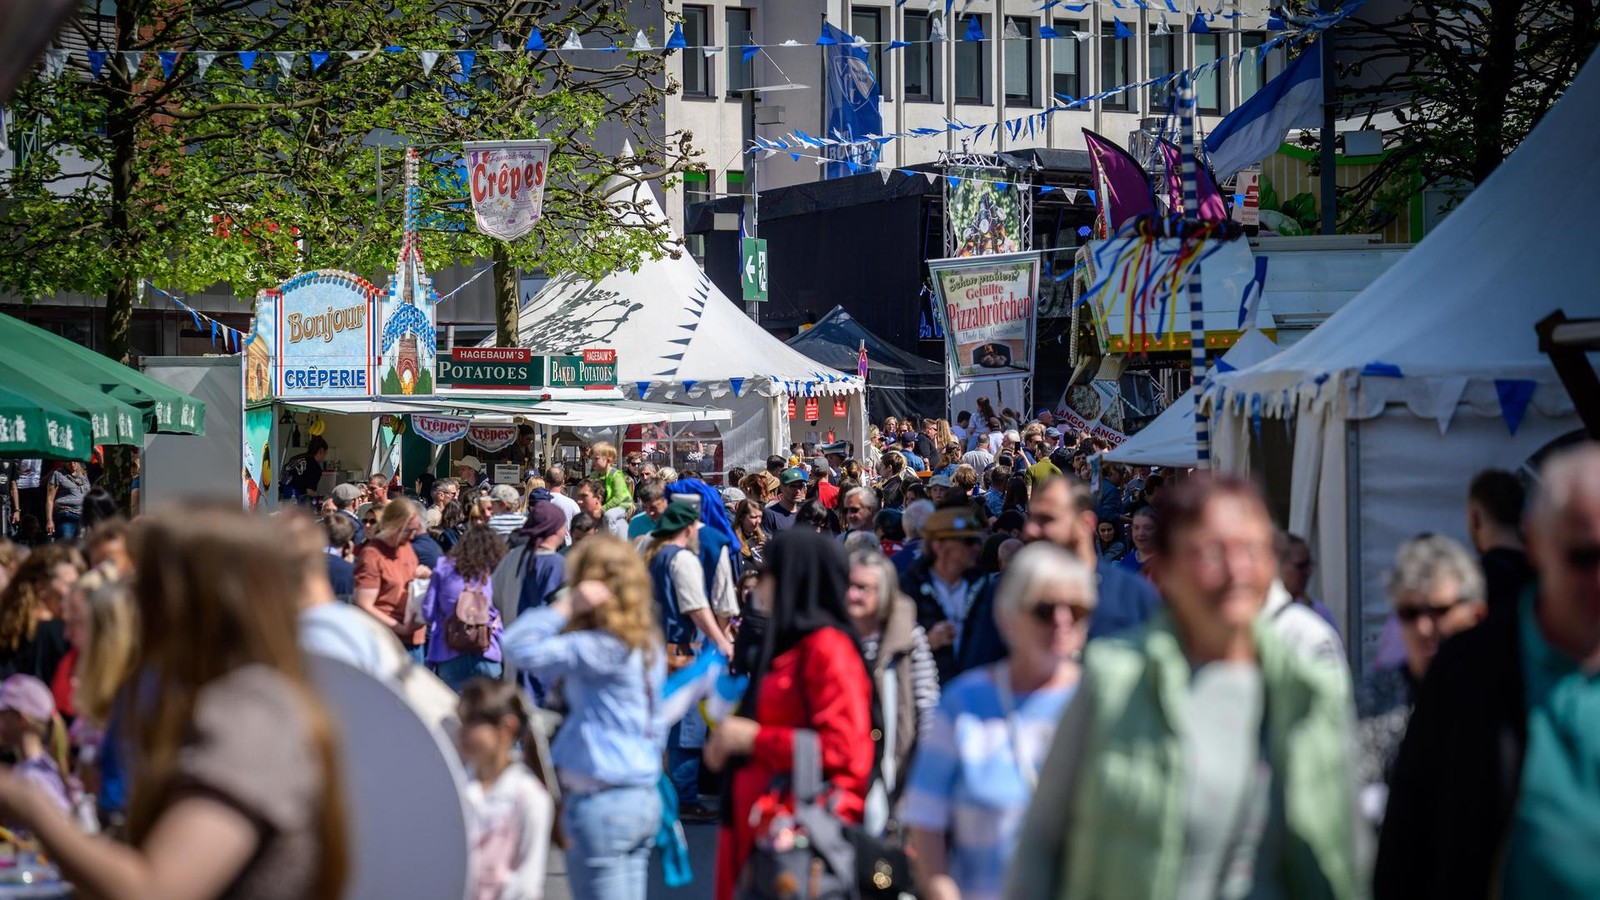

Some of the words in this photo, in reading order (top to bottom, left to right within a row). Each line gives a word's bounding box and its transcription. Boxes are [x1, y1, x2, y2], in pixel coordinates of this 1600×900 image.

[473, 162, 543, 203] Crêpes
[949, 275, 978, 292] Schon
[966, 283, 1004, 300] Gefüllte
[947, 291, 1031, 333] Pizzabrötchen
[288, 304, 366, 344] Bonjour
[460, 350, 524, 360] HAGEBAUM'S
[586, 352, 612, 361] HAGEBAUM'S
[284, 365, 367, 389] CRÊPERIE
[437, 361, 527, 380] POTATOES
[420, 418, 461, 434] Crêpes
[1054, 407, 1091, 434] LANGOS
[471, 425, 510, 441] Crêpes
